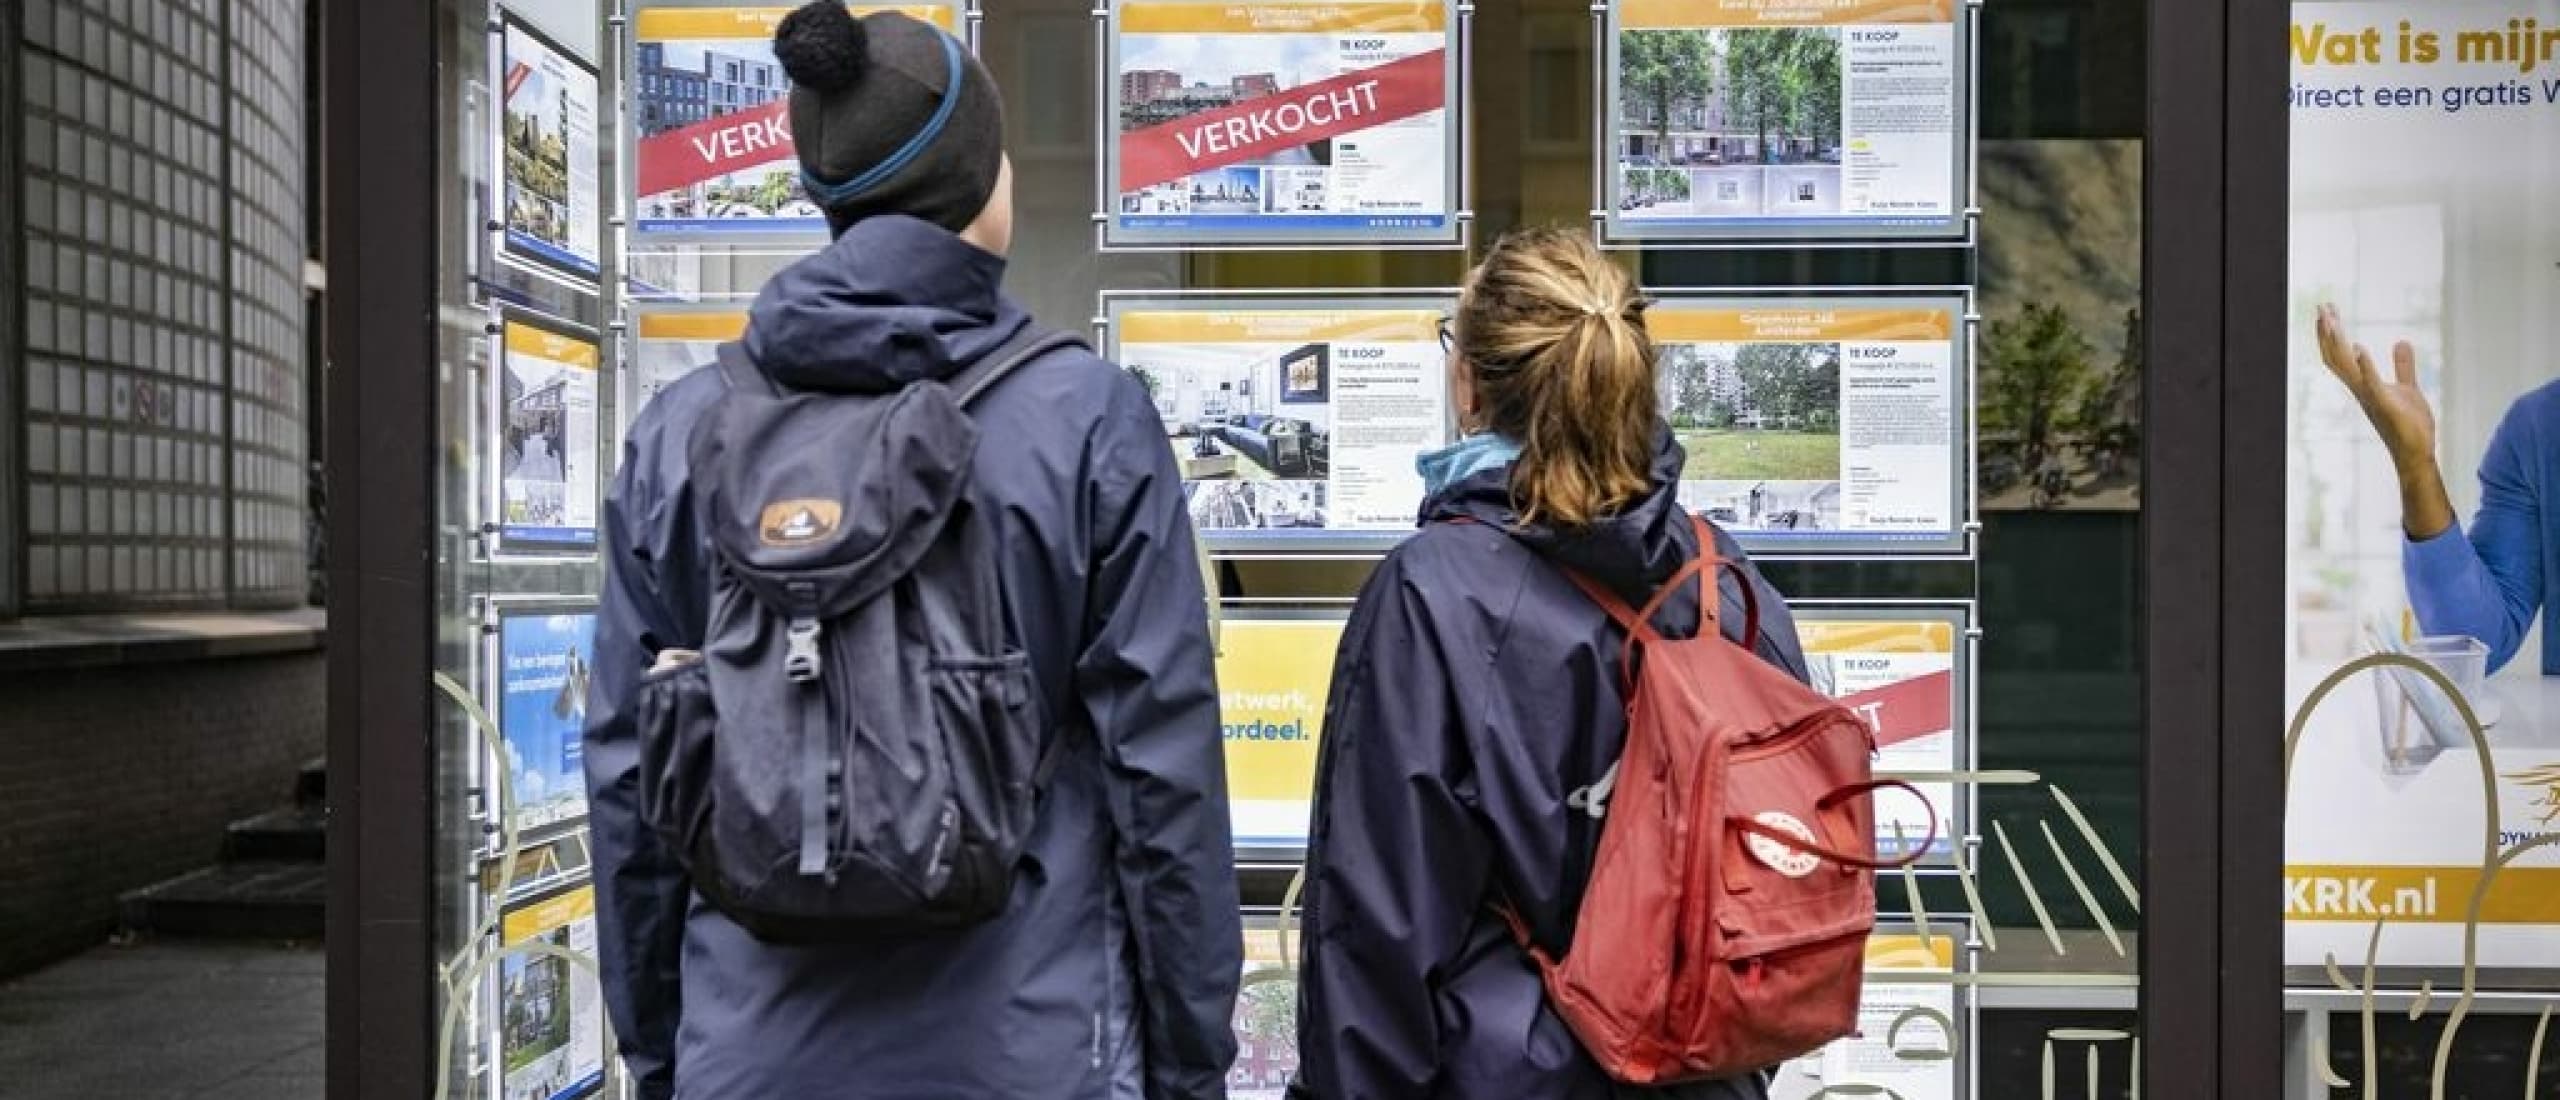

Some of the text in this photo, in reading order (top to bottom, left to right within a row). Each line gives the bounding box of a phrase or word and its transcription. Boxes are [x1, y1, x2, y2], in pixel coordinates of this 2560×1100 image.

[1354, 39, 1387, 50] KOOP
[1865, 31, 1899, 41] KOOP
[2290, 22, 2382, 65] Wat
[2399, 19, 2442, 64] is
[2374, 87, 2433, 106] een
[2442, 80, 2532, 112] gratis
[1176, 80, 1379, 159] VERKOCHT
[691, 112, 794, 164] VERK
[1352, 348, 1386, 358] KOOP
[1863, 348, 1898, 358] KOOP
[1857, 659, 1891, 669] KOOP
[1222, 717, 1310, 741] ordeel.
[2284, 876, 2437, 916] KRK.nl
